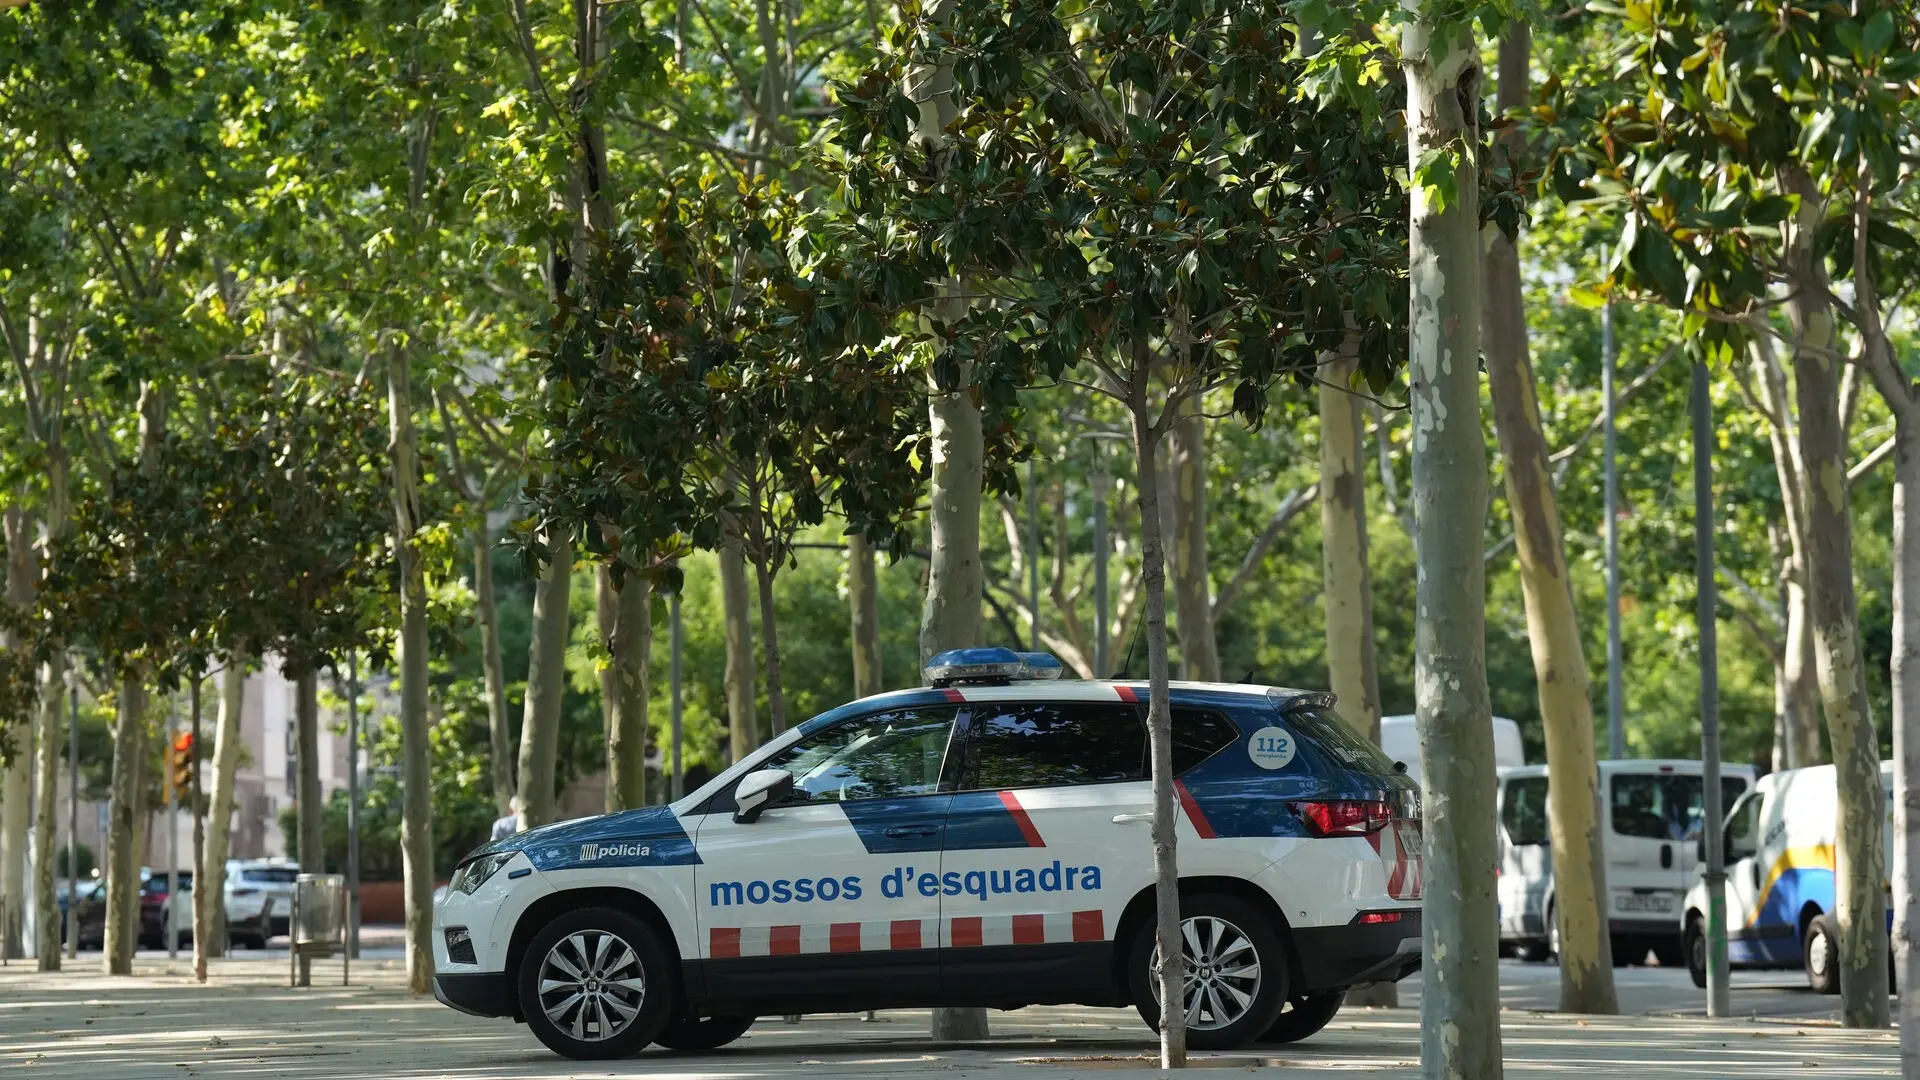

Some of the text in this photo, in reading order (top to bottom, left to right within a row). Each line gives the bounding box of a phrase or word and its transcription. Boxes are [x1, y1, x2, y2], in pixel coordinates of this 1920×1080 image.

[1256, 737, 1288, 752] 112
[598, 844, 650, 859] policia
[710, 860, 1102, 906] mossos d’esquadra
